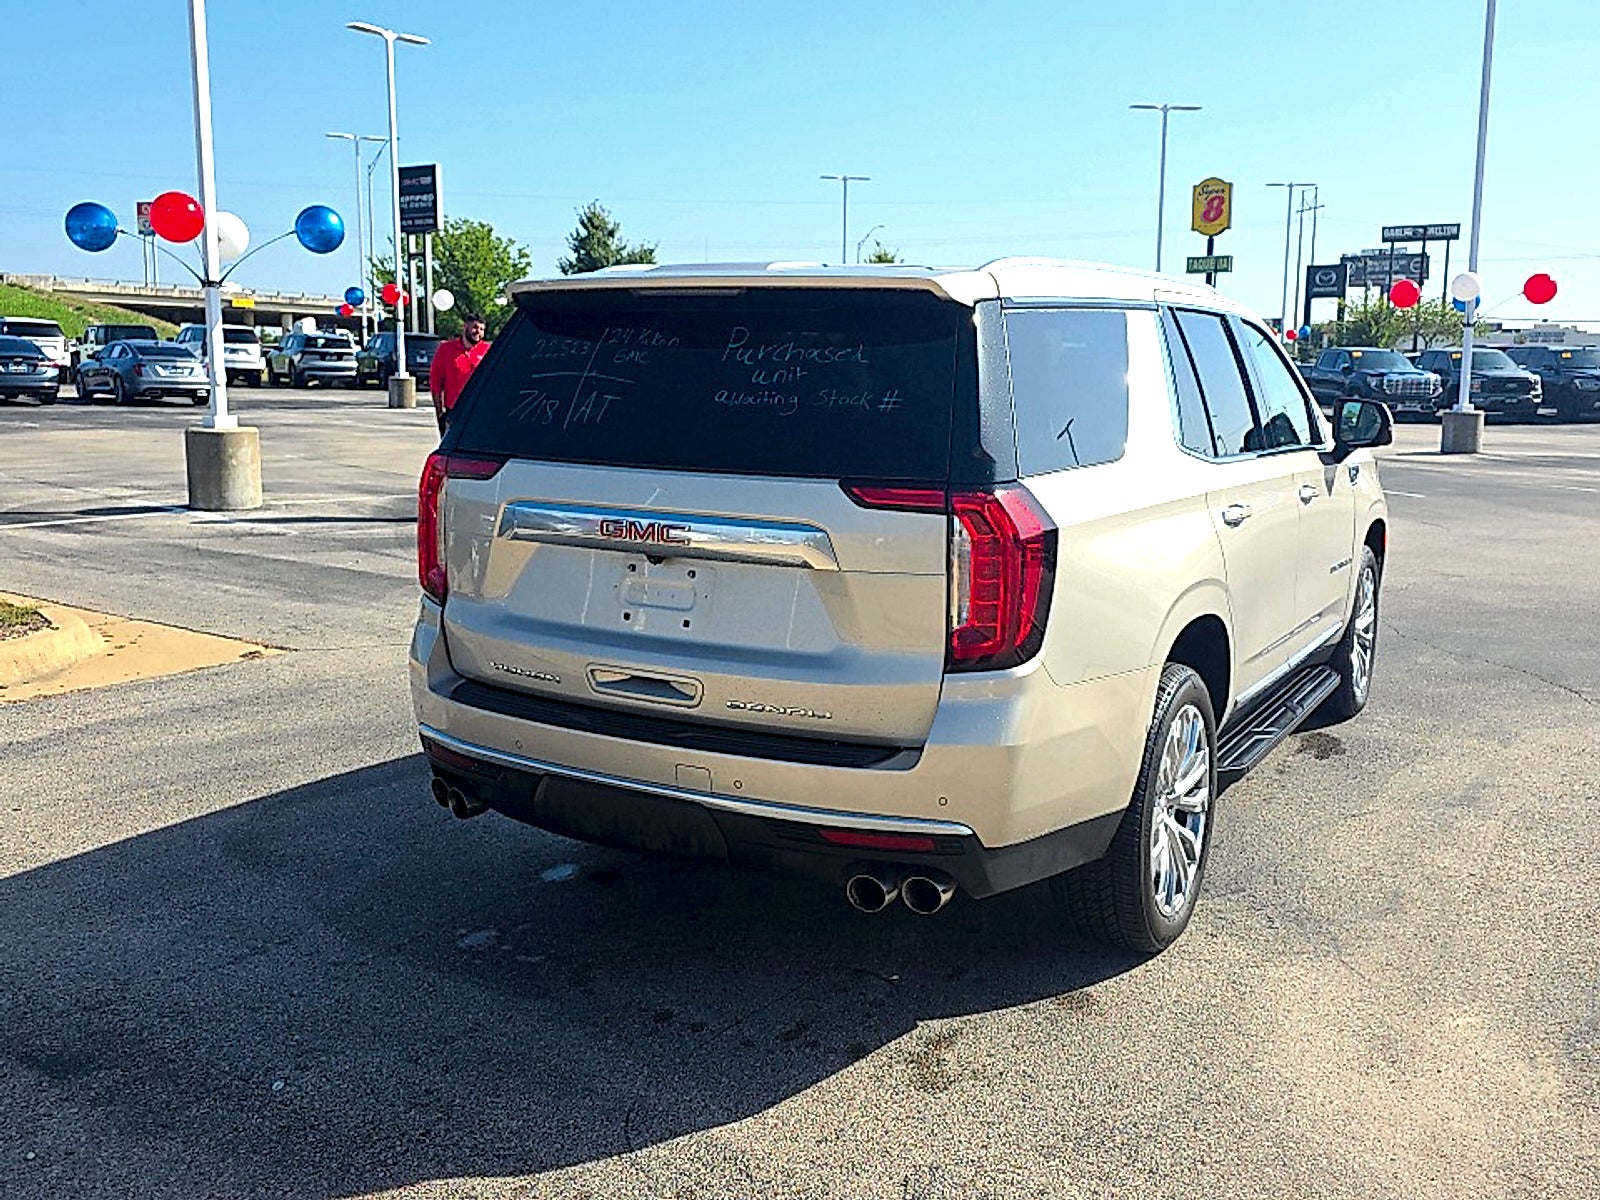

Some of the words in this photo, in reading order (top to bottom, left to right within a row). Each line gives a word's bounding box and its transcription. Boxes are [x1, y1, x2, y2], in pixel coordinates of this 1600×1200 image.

[1203, 195, 1225, 223] 8
[721, 327, 869, 365] Purchased
[752, 367, 808, 385] unit
[714, 389, 799, 416] awaiting
[877, 389, 905, 413] #
[599, 519, 692, 545] GMC
